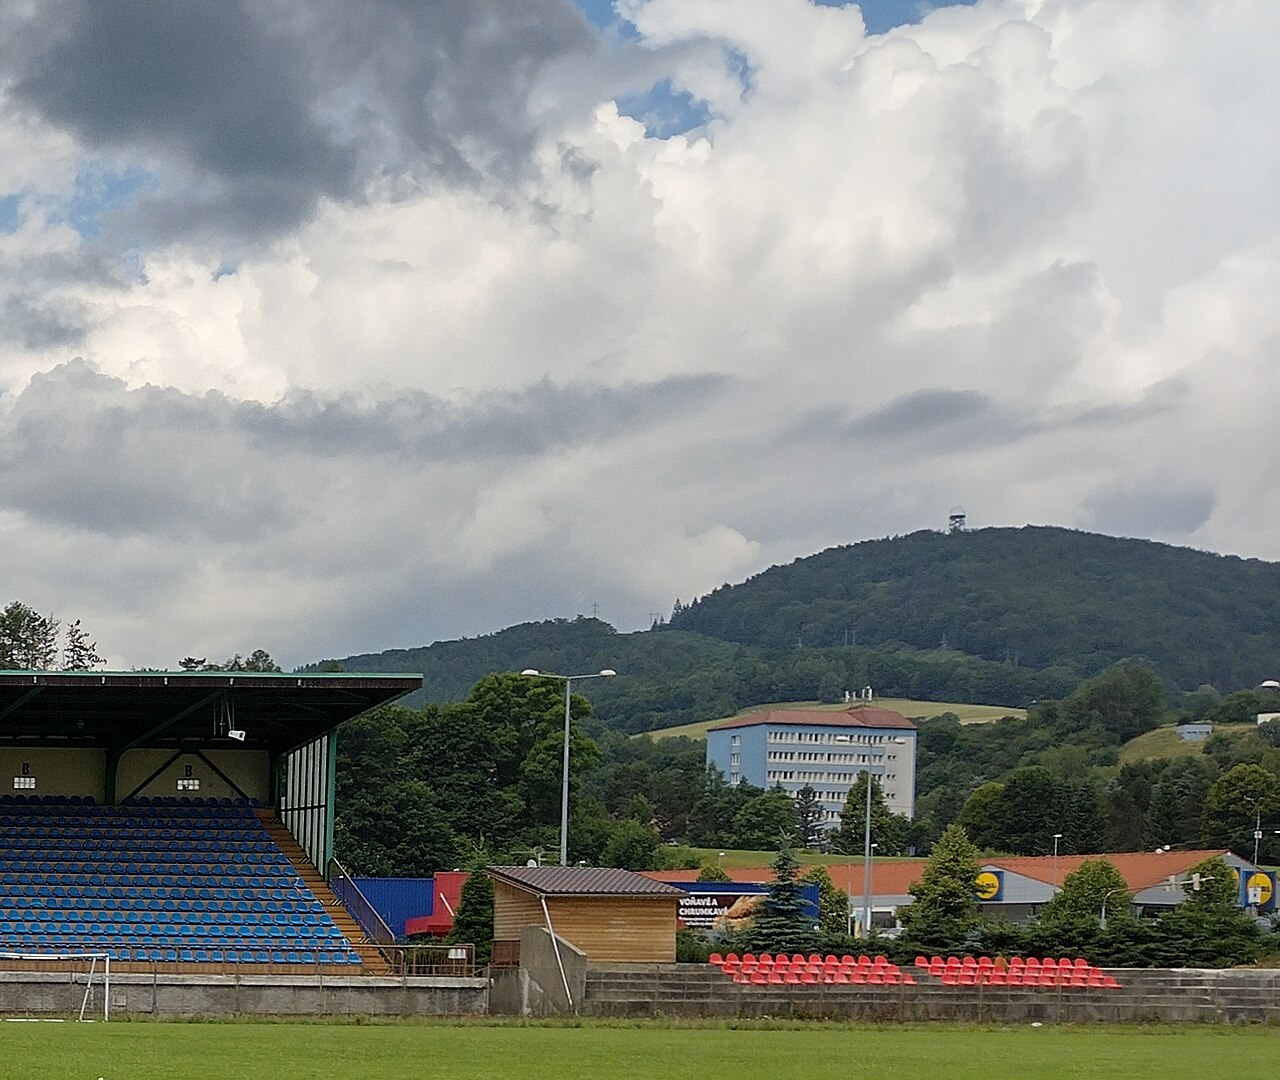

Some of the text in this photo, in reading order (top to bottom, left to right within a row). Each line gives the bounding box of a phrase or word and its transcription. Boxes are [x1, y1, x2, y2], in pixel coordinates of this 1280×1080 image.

[22, 762, 30, 775] B
[184, 764, 192, 777] B
[711, 898, 718, 906] A
